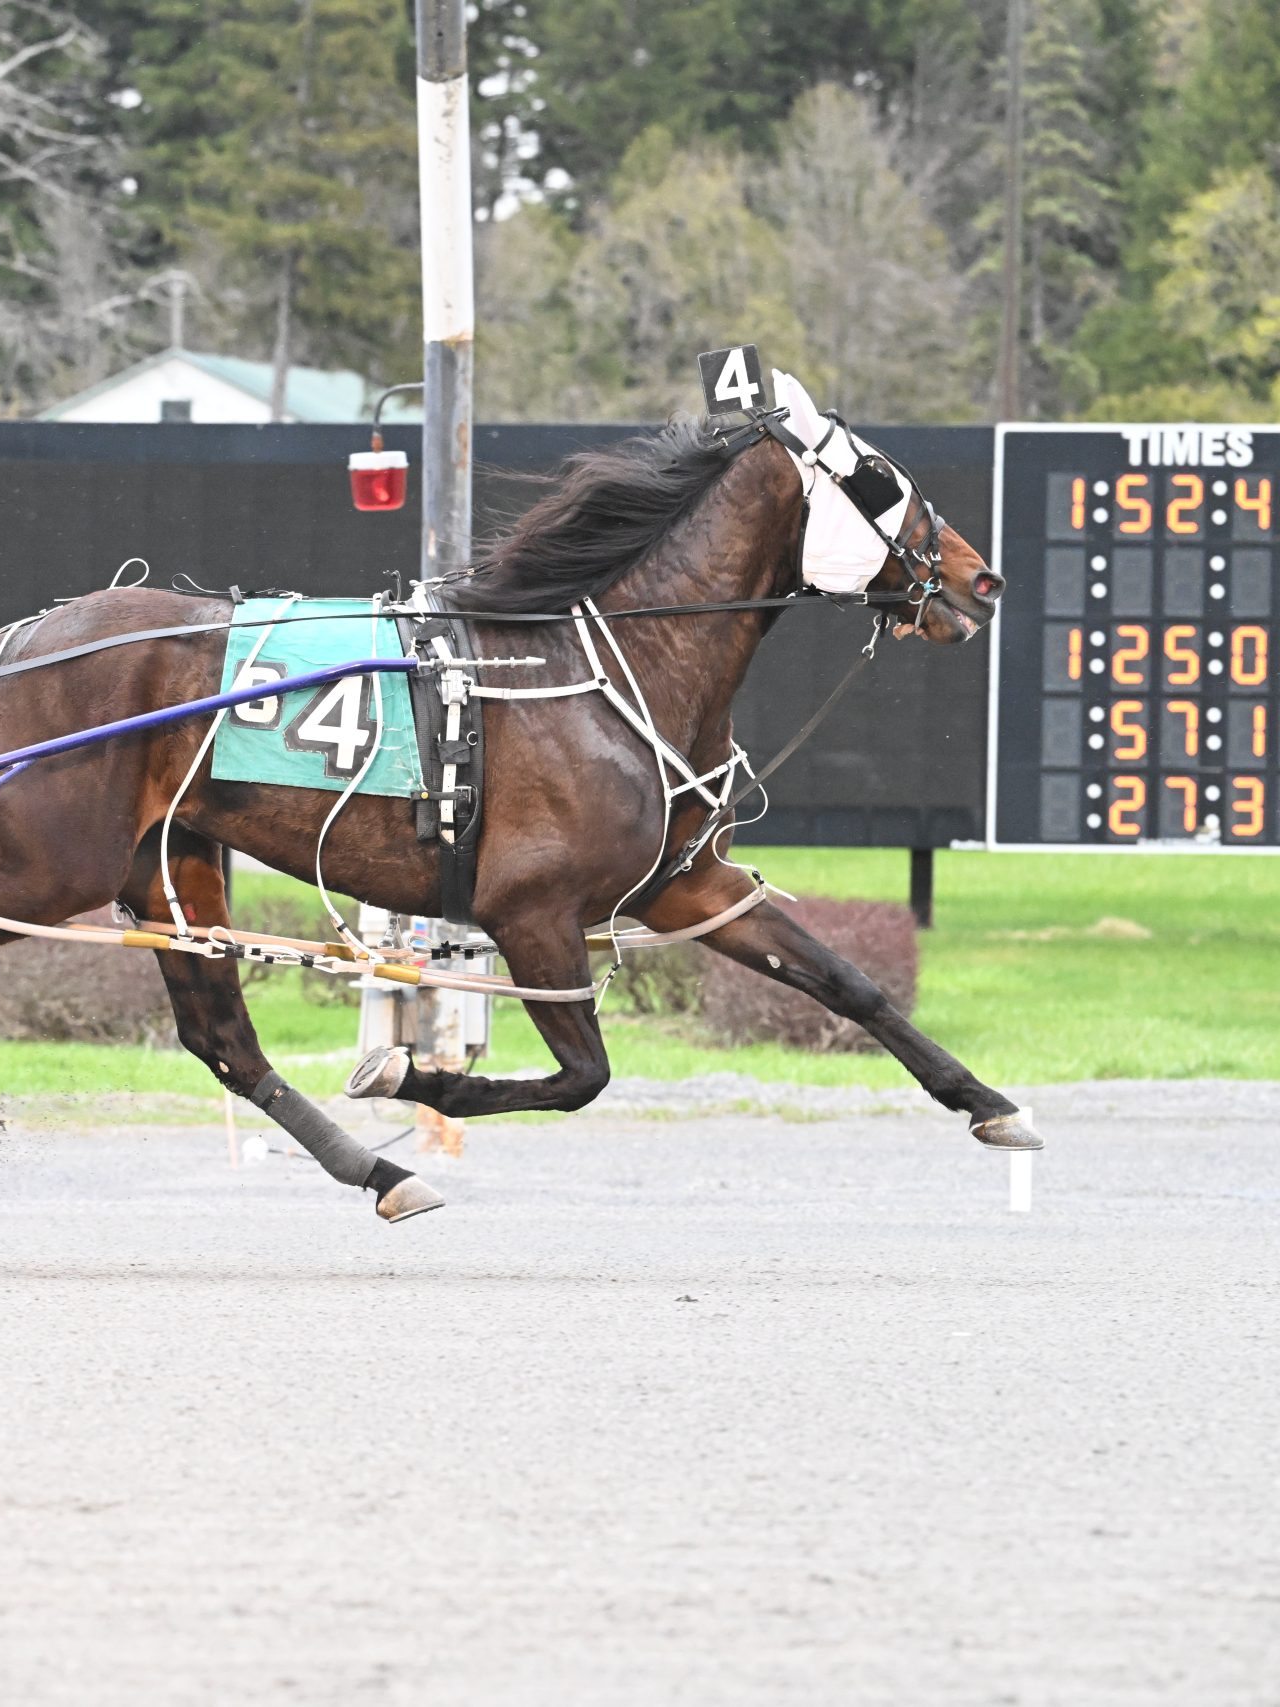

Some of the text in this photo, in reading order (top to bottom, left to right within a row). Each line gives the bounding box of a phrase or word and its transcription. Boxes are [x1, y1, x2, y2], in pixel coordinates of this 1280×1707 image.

[714, 347, 760, 410] 4
[1122, 431, 1254, 467] TIMES
[297, 675, 370, 770] 4
